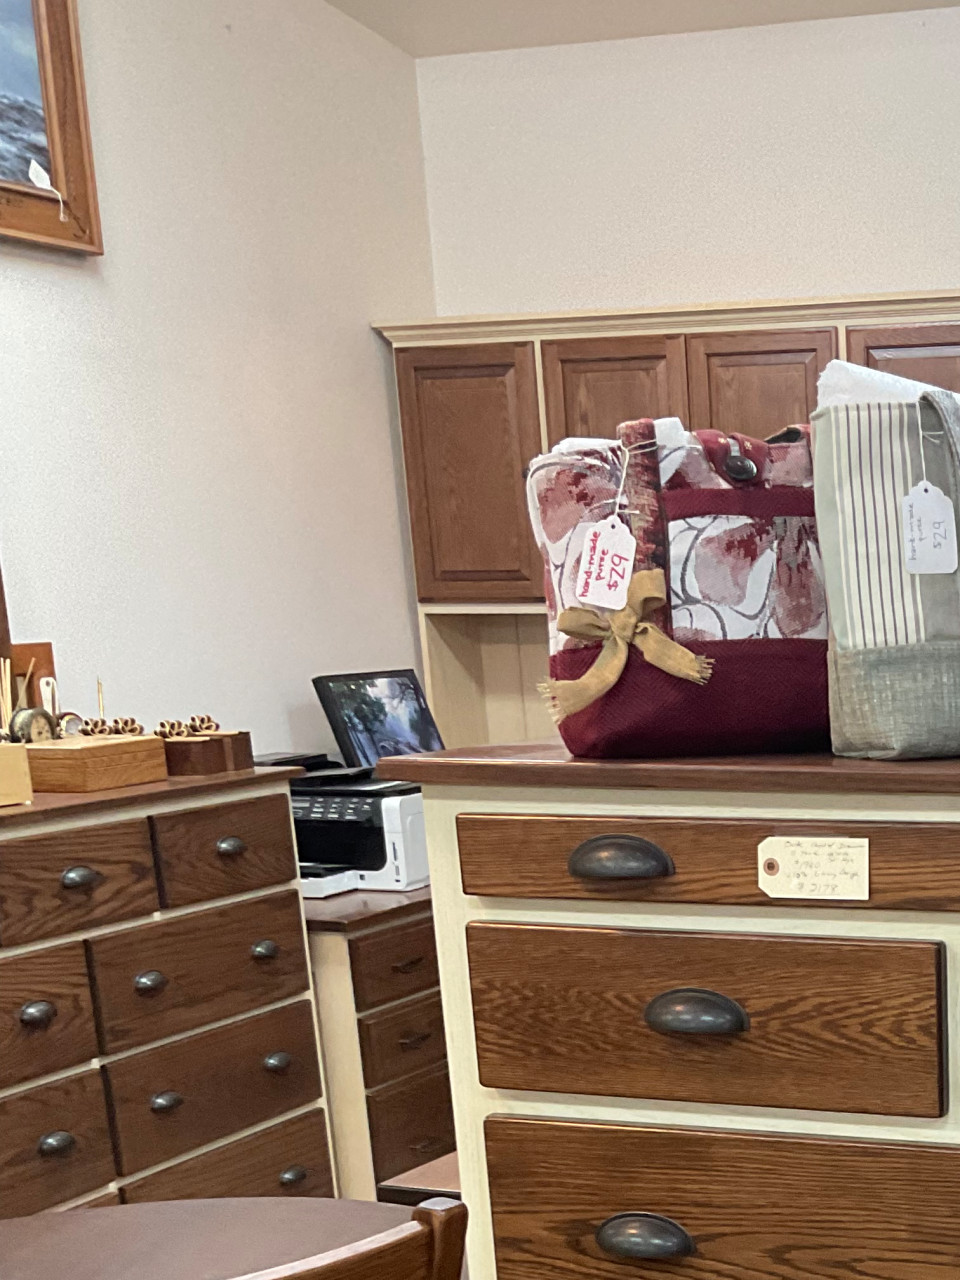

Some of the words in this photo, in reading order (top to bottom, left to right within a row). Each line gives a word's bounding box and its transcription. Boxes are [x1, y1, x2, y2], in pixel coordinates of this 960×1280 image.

[932, 520, 947, 549] $29
[578, 531, 602, 598] hand-made
[595, 549, 609, 582] purse
[606, 554, 631, 592] $29
